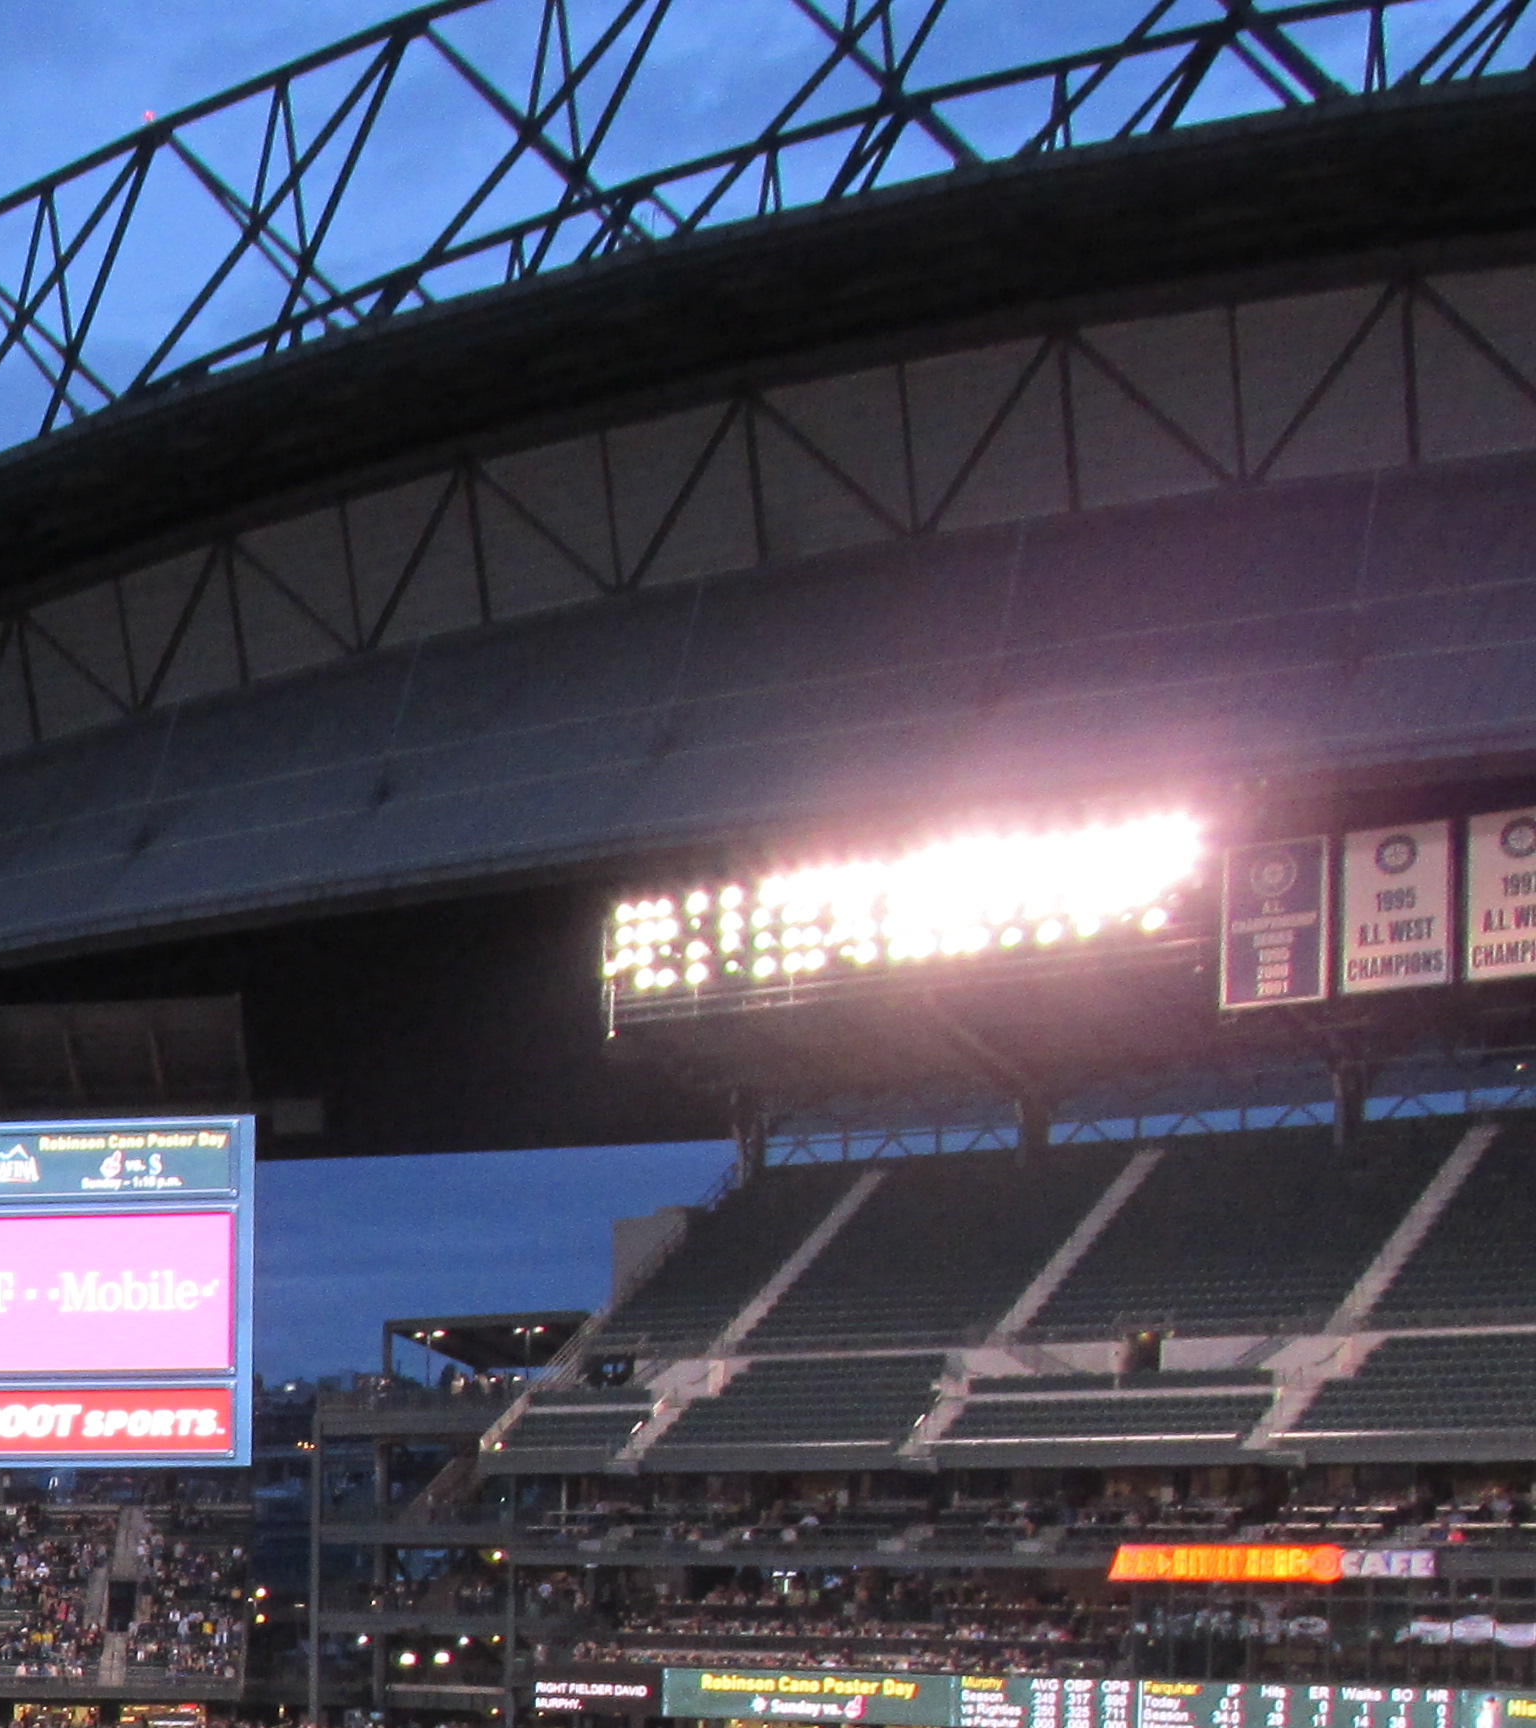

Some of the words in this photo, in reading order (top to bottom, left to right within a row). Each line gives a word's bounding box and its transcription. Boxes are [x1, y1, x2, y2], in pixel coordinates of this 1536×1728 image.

[1347, 950, 1445, 982] CHAMPIONS
[39, 1136, 106, 1152] Robinson
[108, 1134, 144, 1150] Cano
[147, 1132, 196, 1149] Poster
[198, 1131, 228, 1150] Day
[1341, 1549, 1435, 1578] CAFE
[536, 1682, 568, 1693] RIGHT
[568, 1683, 612, 1695] FIELDER
[614, 1685, 648, 1696] DAVID
[702, 1674, 775, 1692] Robinson
[778, 1676, 820, 1693] Cano
[824, 1677, 880, 1696] Poster
[883, 1679, 918, 1700] Day
[961, 1676, 1003, 1690] Murphy
[1030, 1678, 1059, 1692] AVG
[1064, 1679, 1093, 1692] OBP
[1101, 1680, 1130, 1693] OPS
[1144, 1682, 1197, 1696] Farquhar
[1342, 1688, 1382, 1701] Walks
[536, 1698, 582, 1710] MURPHY.
[961, 1690, 1004, 1702] Season
[1144, 1696, 1180, 1710] Today
[771, 1699, 822, 1717] Sunday
[823, 1703, 842, 1716] vs.
[1144, 1709, 1188, 1722] Season
